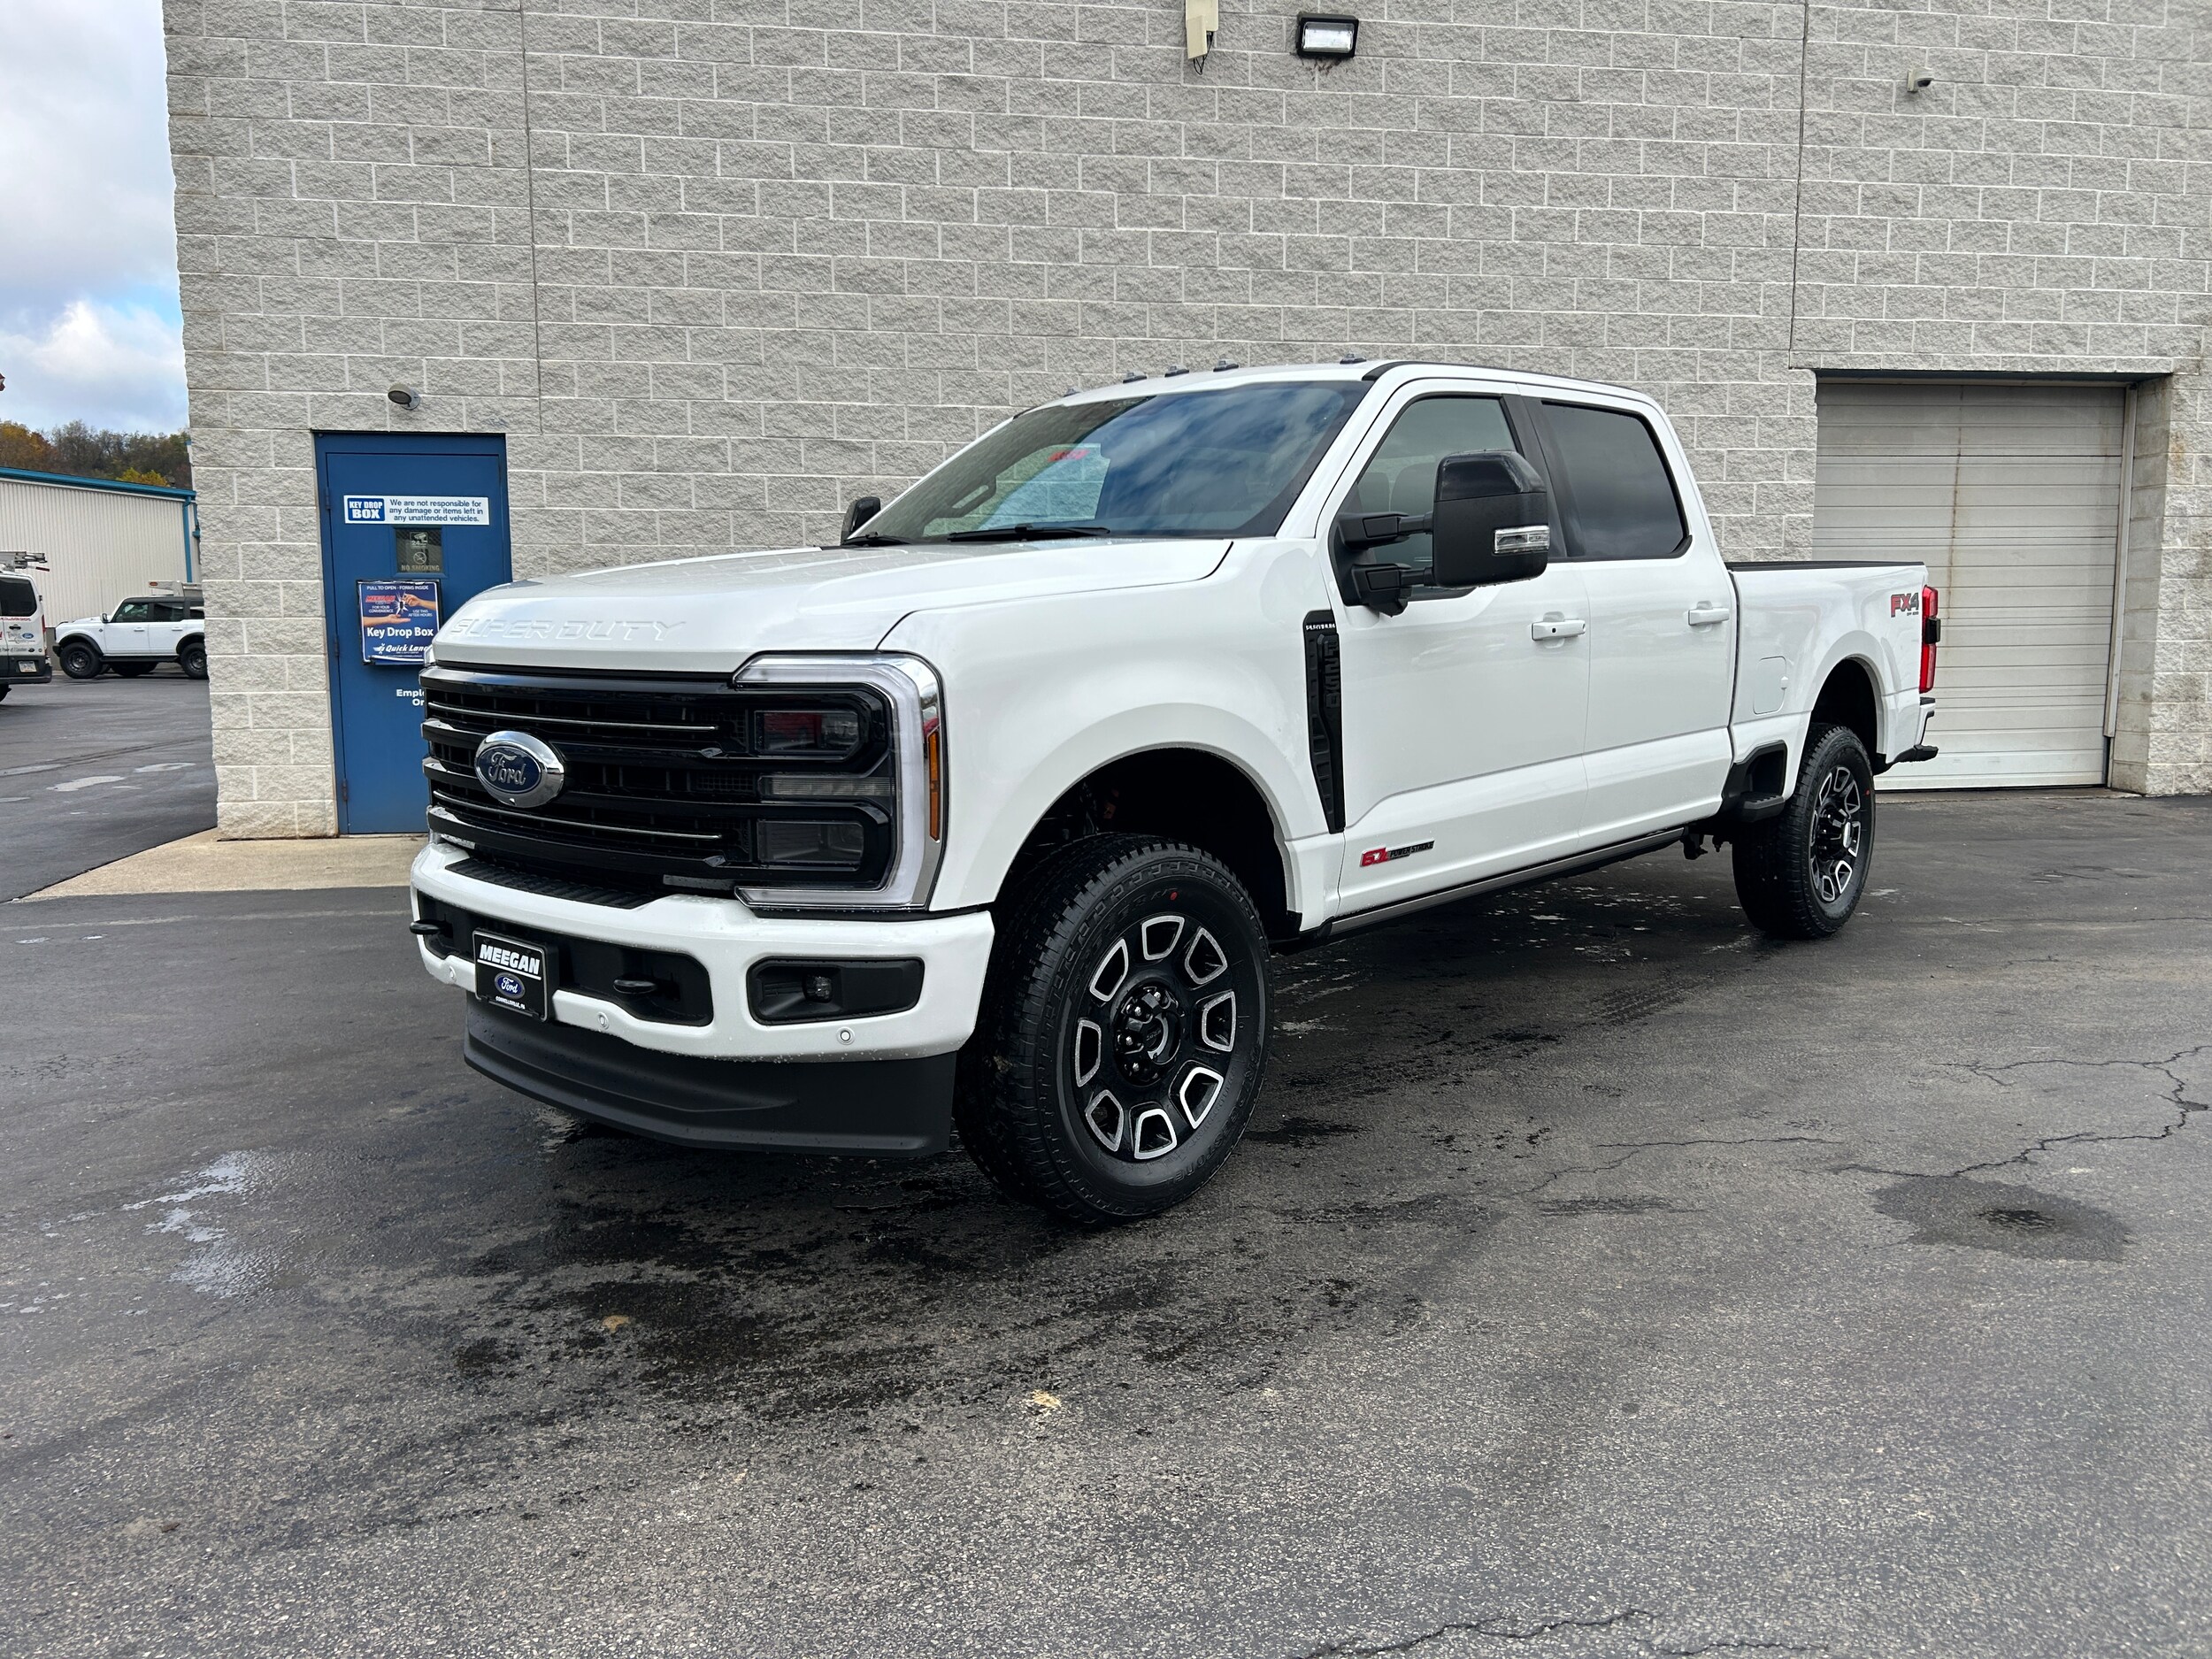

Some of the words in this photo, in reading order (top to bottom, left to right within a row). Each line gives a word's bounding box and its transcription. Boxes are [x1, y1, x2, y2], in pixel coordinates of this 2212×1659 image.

[352, 509, 380, 518] BOX
[364, 501, 383, 510] DROP
[1891, 592, 1919, 618] FX4
[366, 627, 385, 640] Key
[387, 627, 412, 639] Drop
[414, 627, 434, 637] Box
[450, 618, 553, 640] SUPER
[556, 621, 687, 641] DUTY
[488, 752, 526, 786] Ford
[479, 943, 541, 975] MEEGAN
[501, 977, 518, 994] Ford
